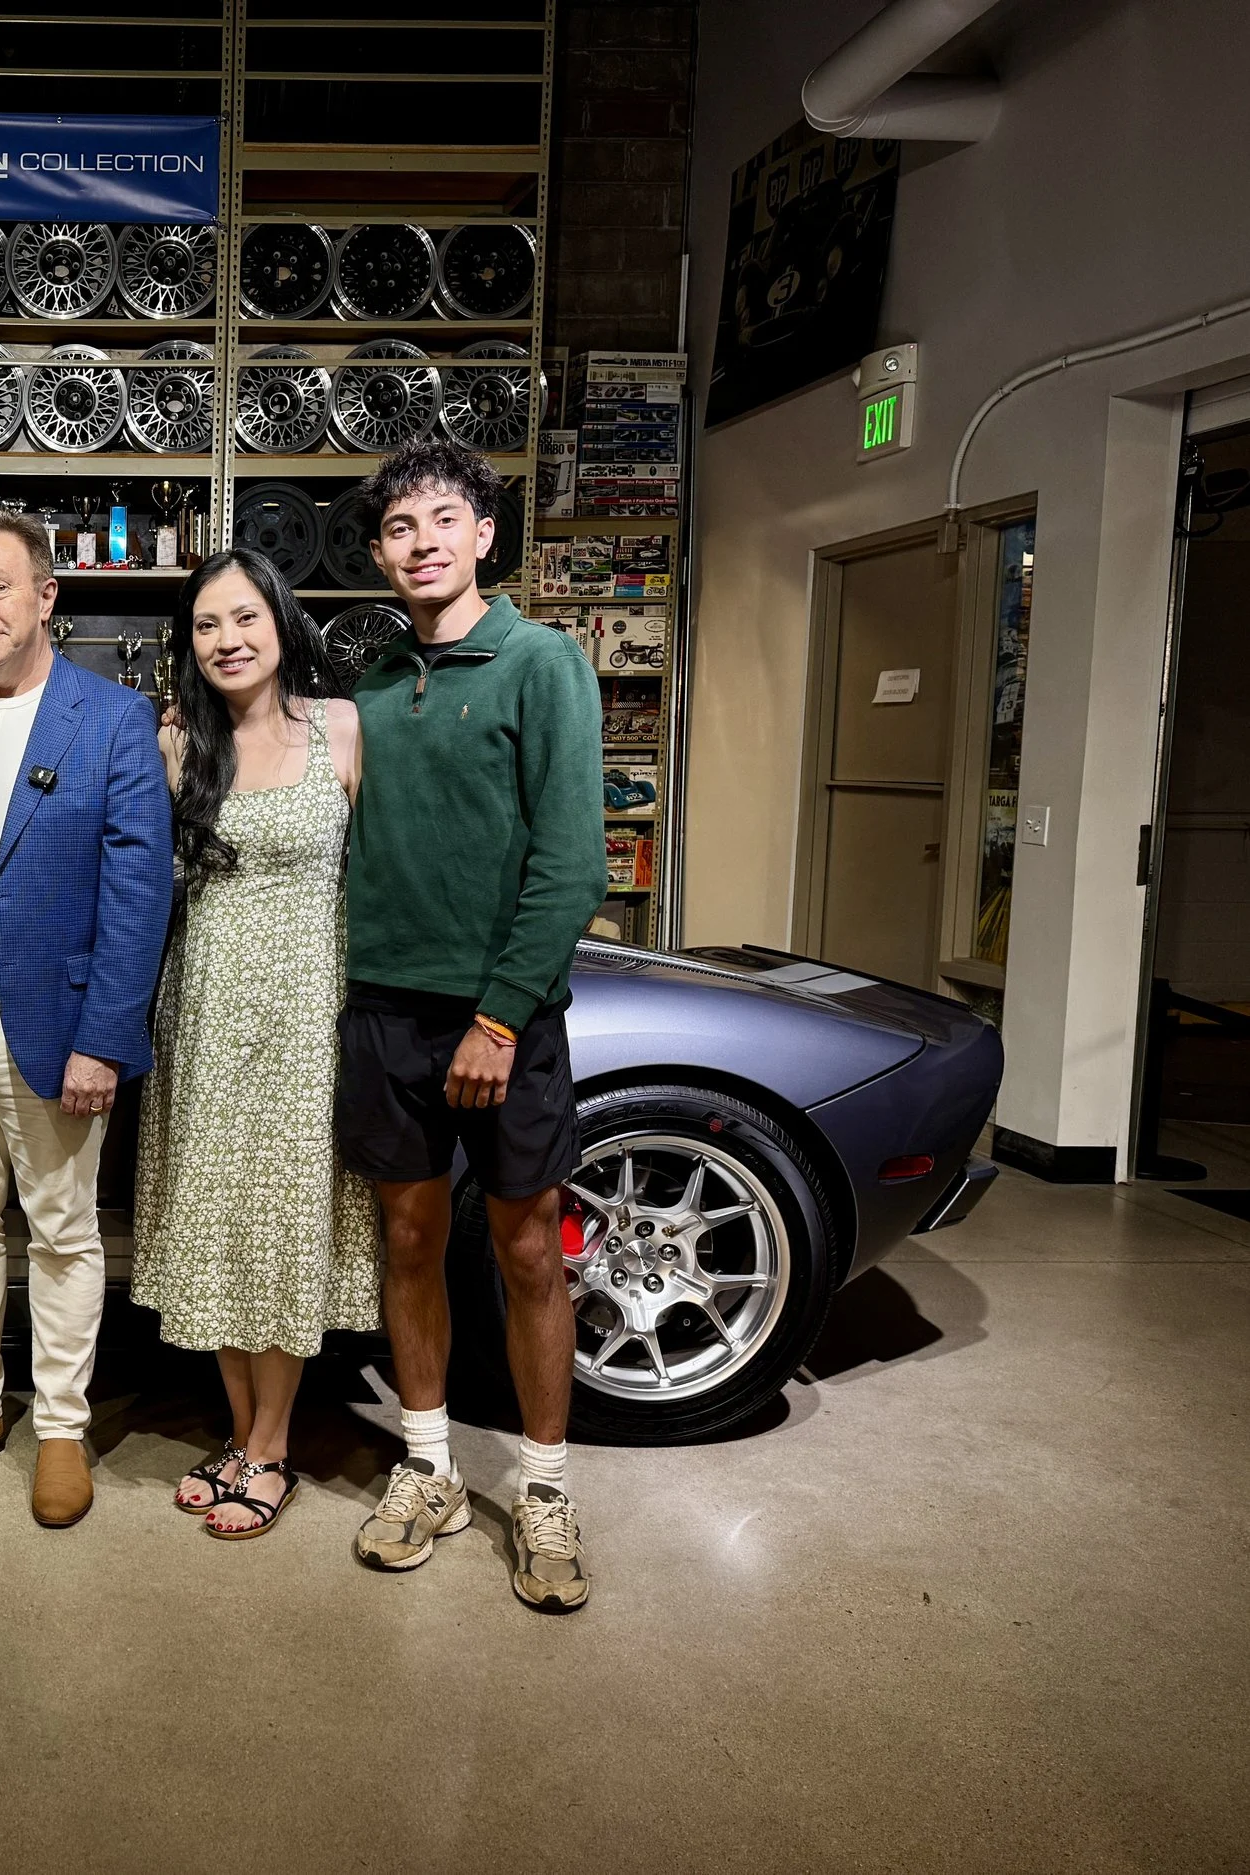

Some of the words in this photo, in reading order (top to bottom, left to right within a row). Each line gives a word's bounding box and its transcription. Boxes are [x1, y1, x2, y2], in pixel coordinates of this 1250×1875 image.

[20, 153, 203, 173] COLLECTION
[802, 155, 823, 190] BP
[769, 174, 788, 209] BP
[863, 395, 897, 449] EXIT
[989, 795, 1010, 808] TARGA
